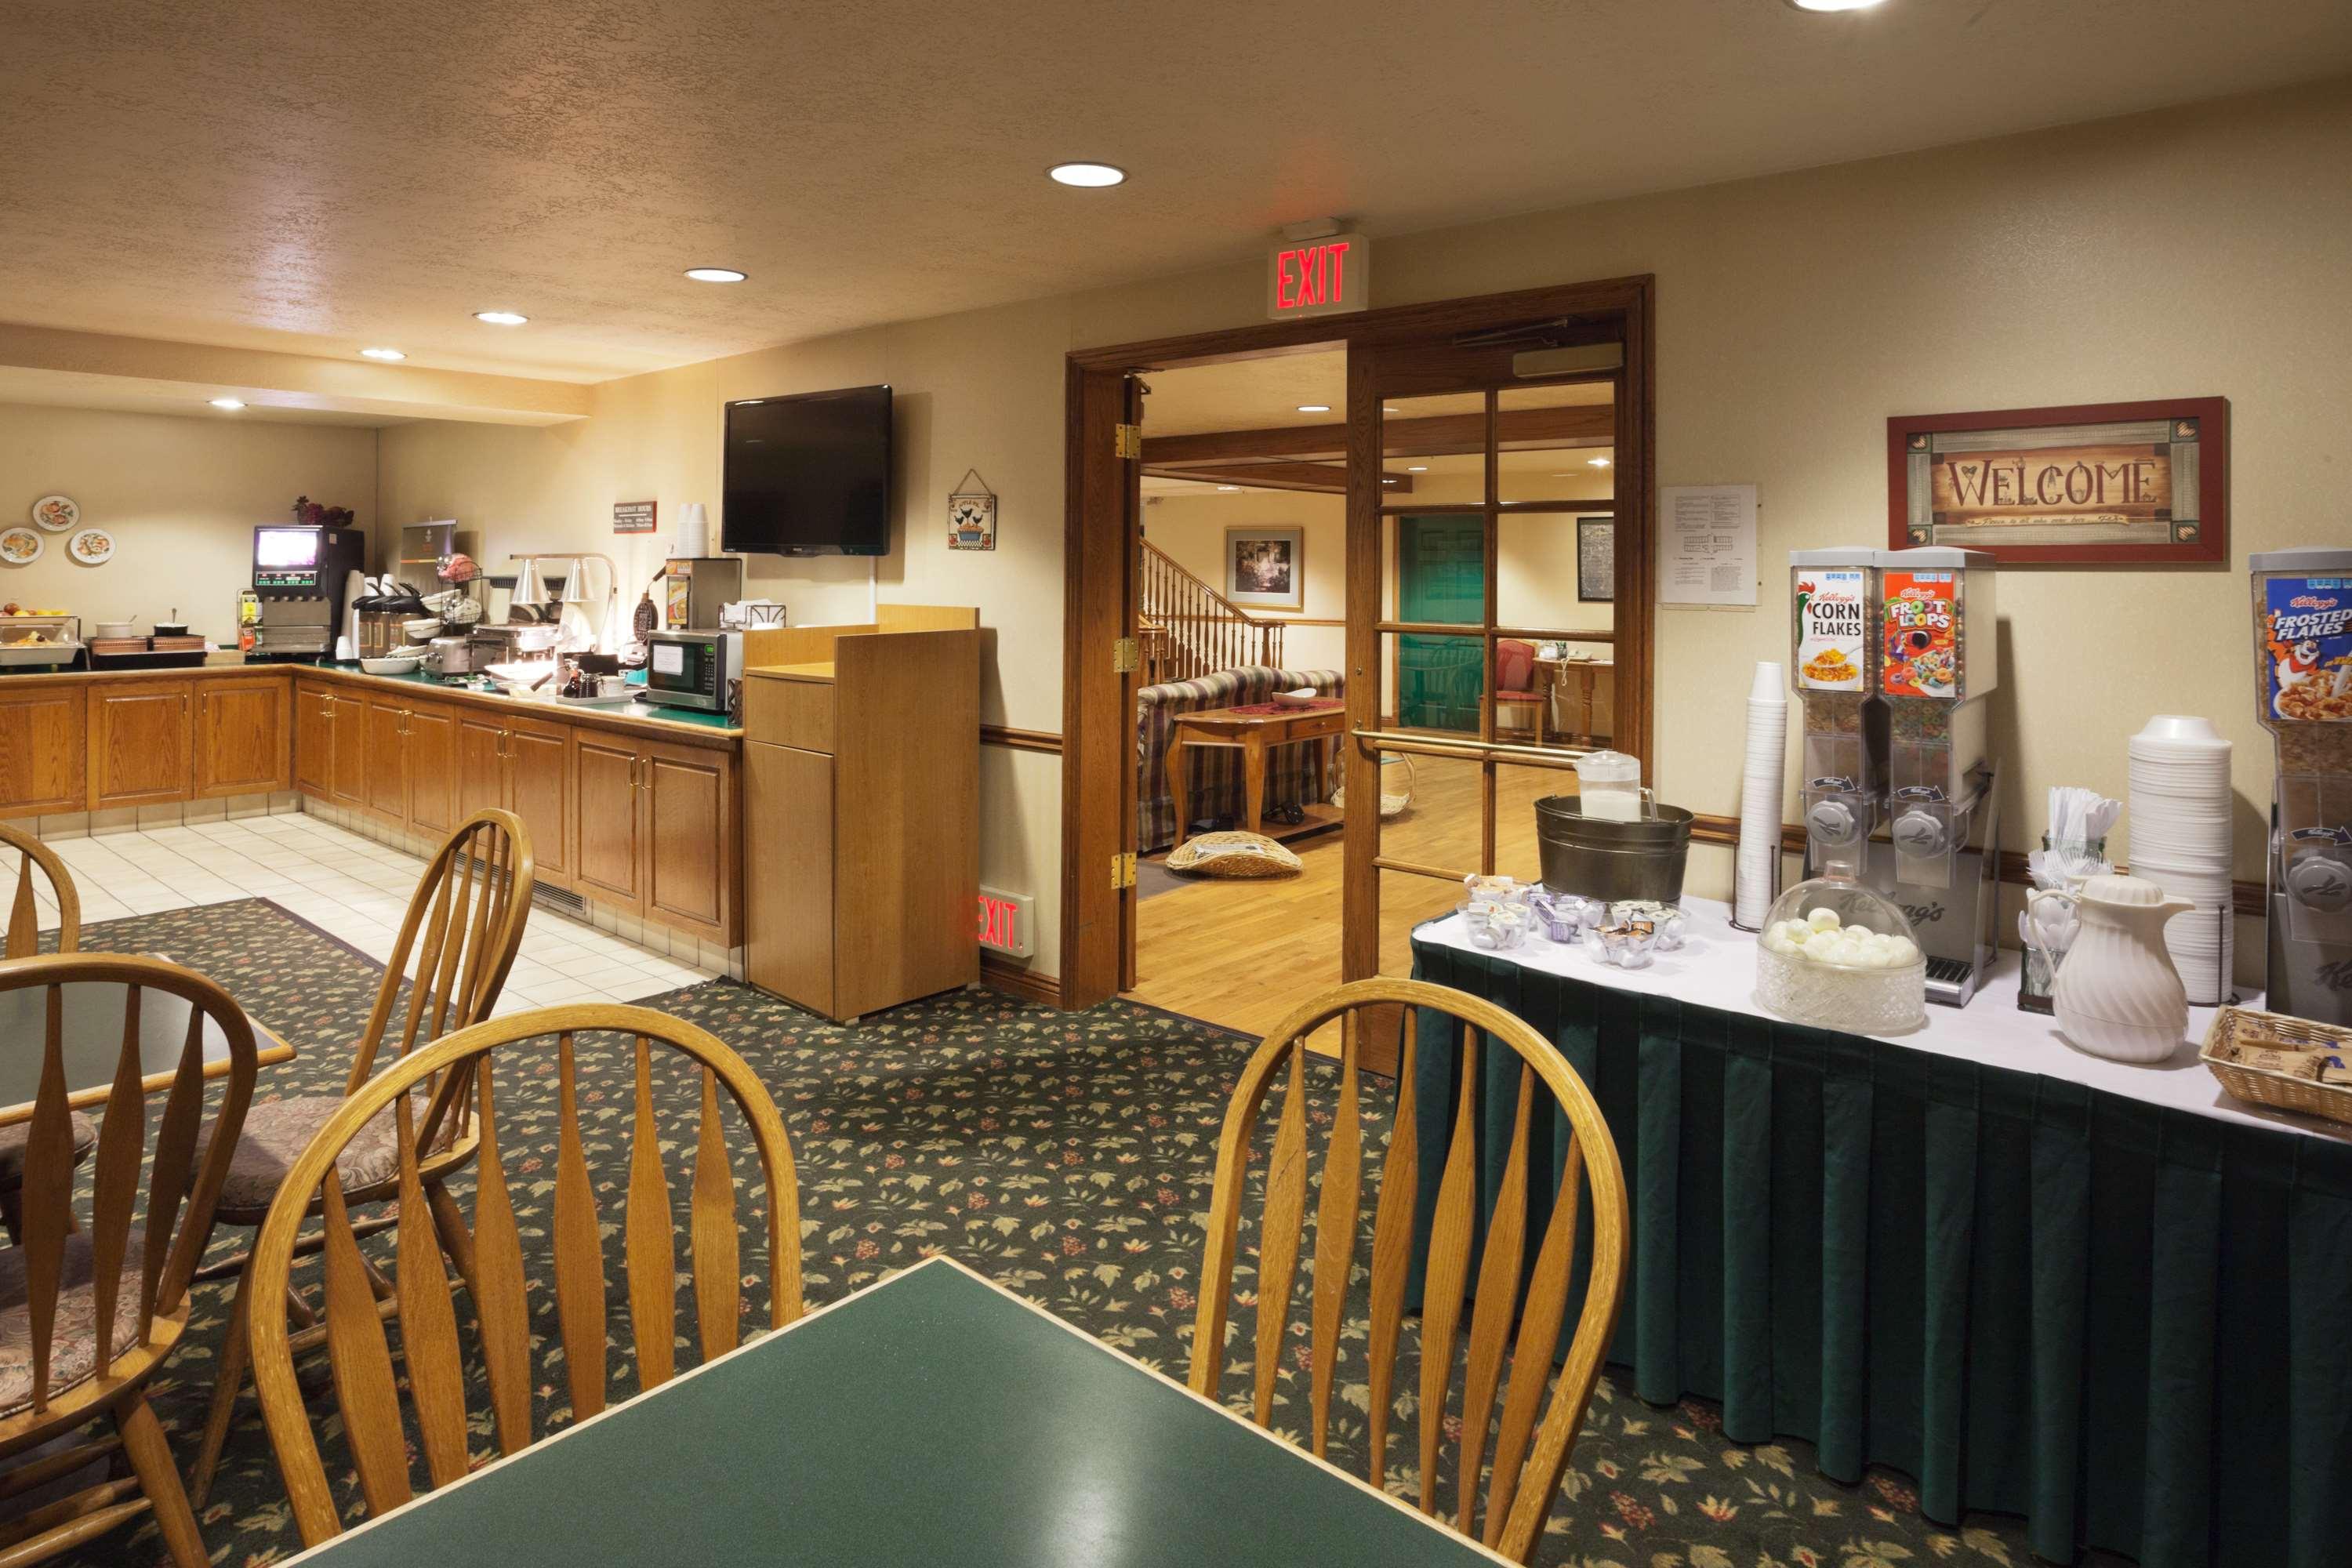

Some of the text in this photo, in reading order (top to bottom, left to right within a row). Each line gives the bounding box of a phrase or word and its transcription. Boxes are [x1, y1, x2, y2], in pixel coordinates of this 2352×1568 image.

[1277, 242, 1349, 309] EXIT
[1946, 456, 2157, 506] WELCOME
[1819, 593, 1856, 604] Kellogg's
[1900, 588, 1935, 599] Kellogg's
[1891, 600, 1946, 617] FROOT
[2290, 596, 2338, 609] Kellogg's
[1813, 604, 1860, 619] CORN
[2276, 608, 2352, 630] FROSTED
[1813, 622, 1861, 636] FLAKES
[1899, 613, 1952, 629] LOOPS
[2278, 622, 2343, 641] FLAKES
